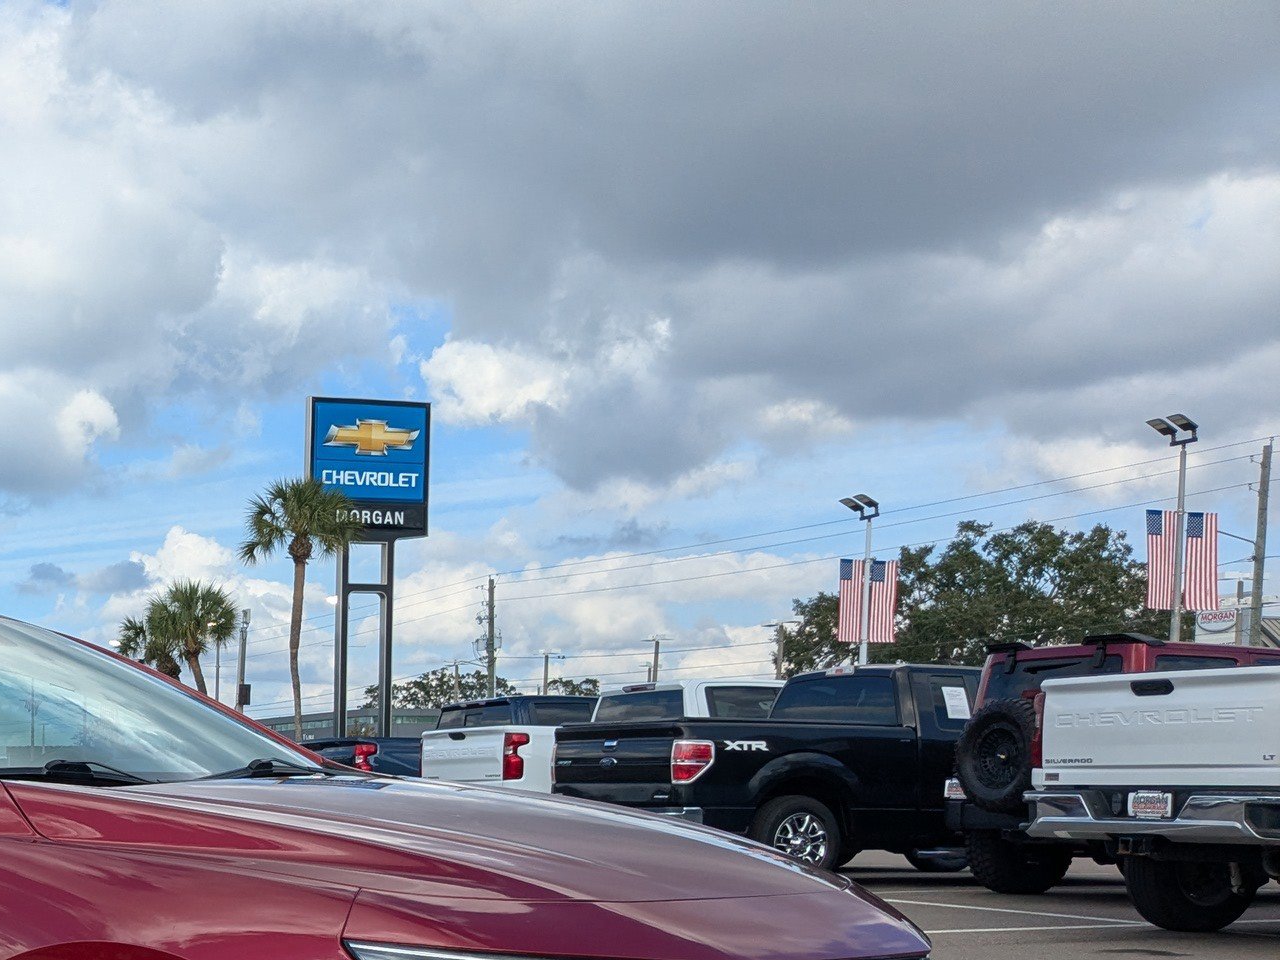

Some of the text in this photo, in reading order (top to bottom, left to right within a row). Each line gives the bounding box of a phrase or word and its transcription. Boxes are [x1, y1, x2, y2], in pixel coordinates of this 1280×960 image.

[322, 470, 419, 488] CHEVROLET
[1200, 612, 1235, 621] MORGAN
[1055, 707, 1264, 728] CHEVROLET
[723, 740, 770, 751] XTR
